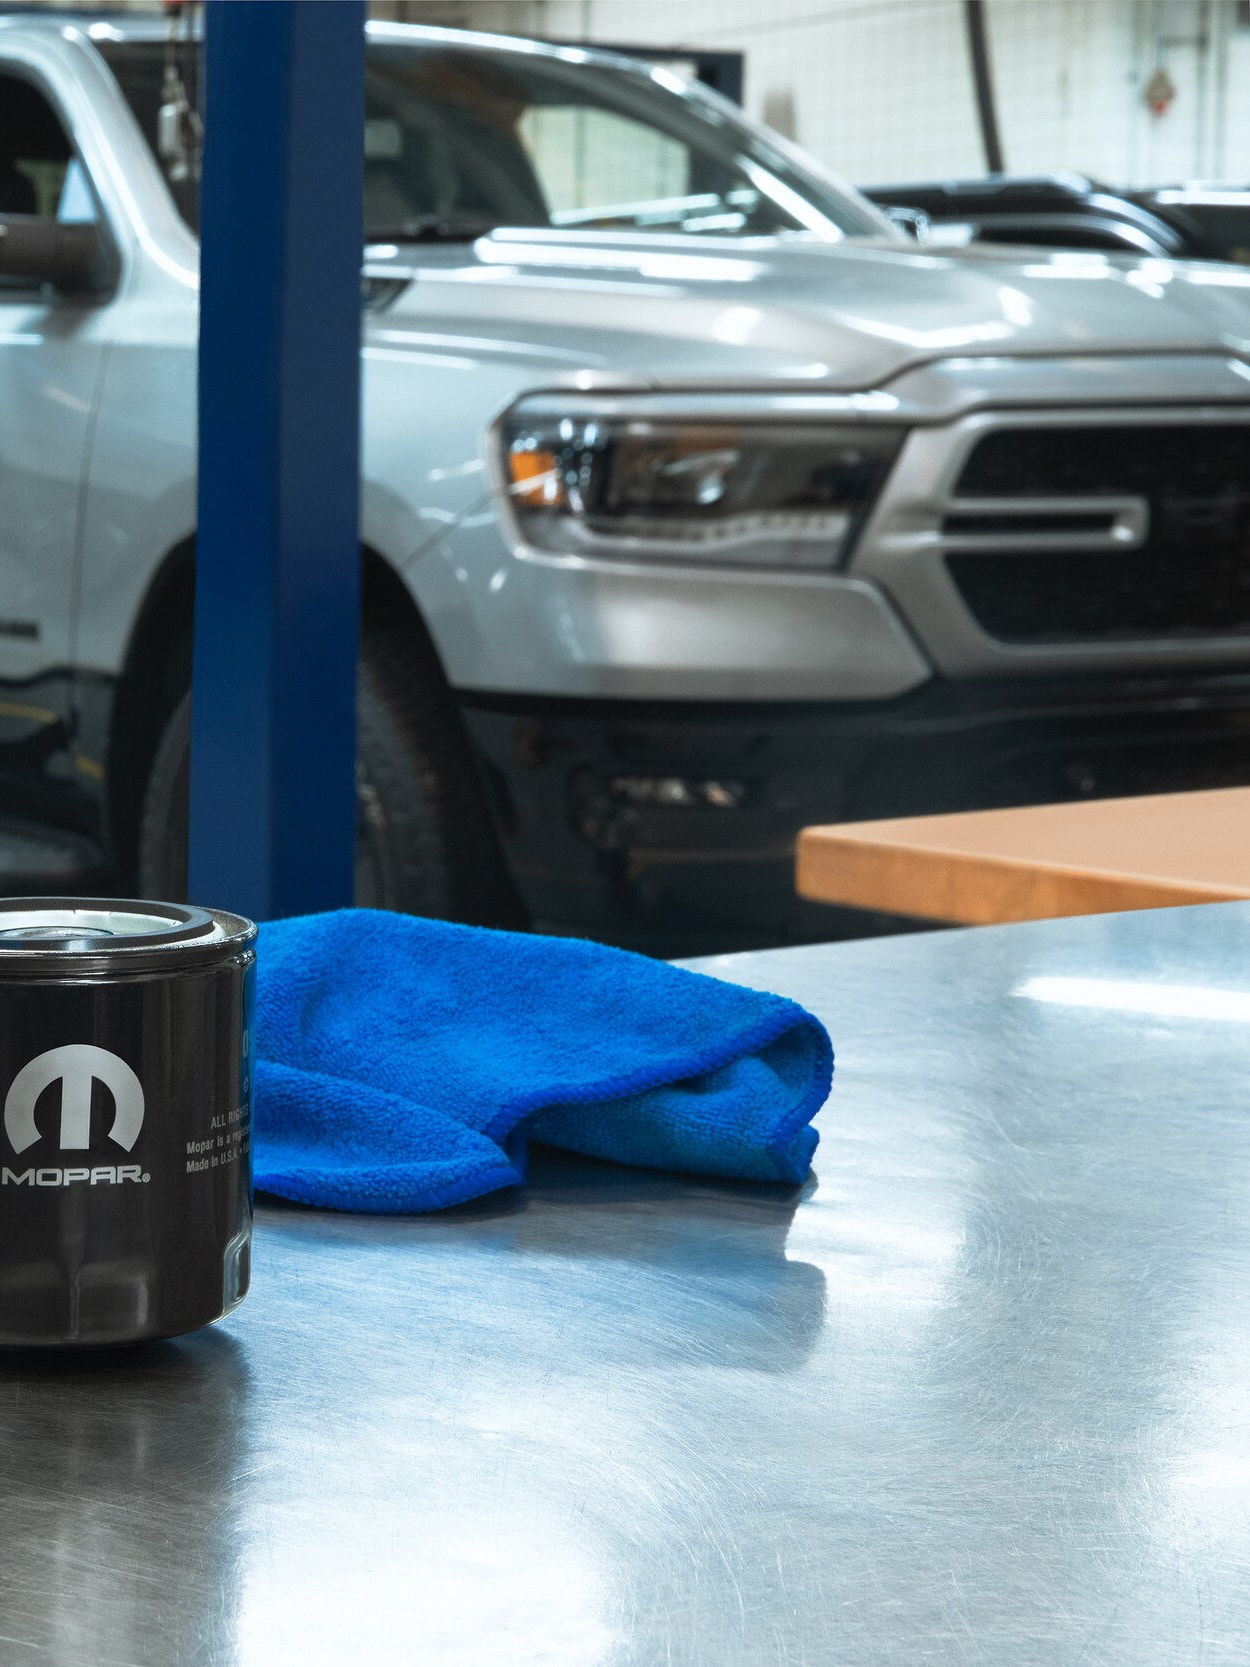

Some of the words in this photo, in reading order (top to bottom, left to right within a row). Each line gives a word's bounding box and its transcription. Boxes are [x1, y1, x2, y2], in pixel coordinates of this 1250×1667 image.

[210, 1114, 226, 1130] ALL
[186, 1138, 214, 1155] Mopar
[225, 1134, 231, 1144] a
[186, 1158, 209, 1173] Made
